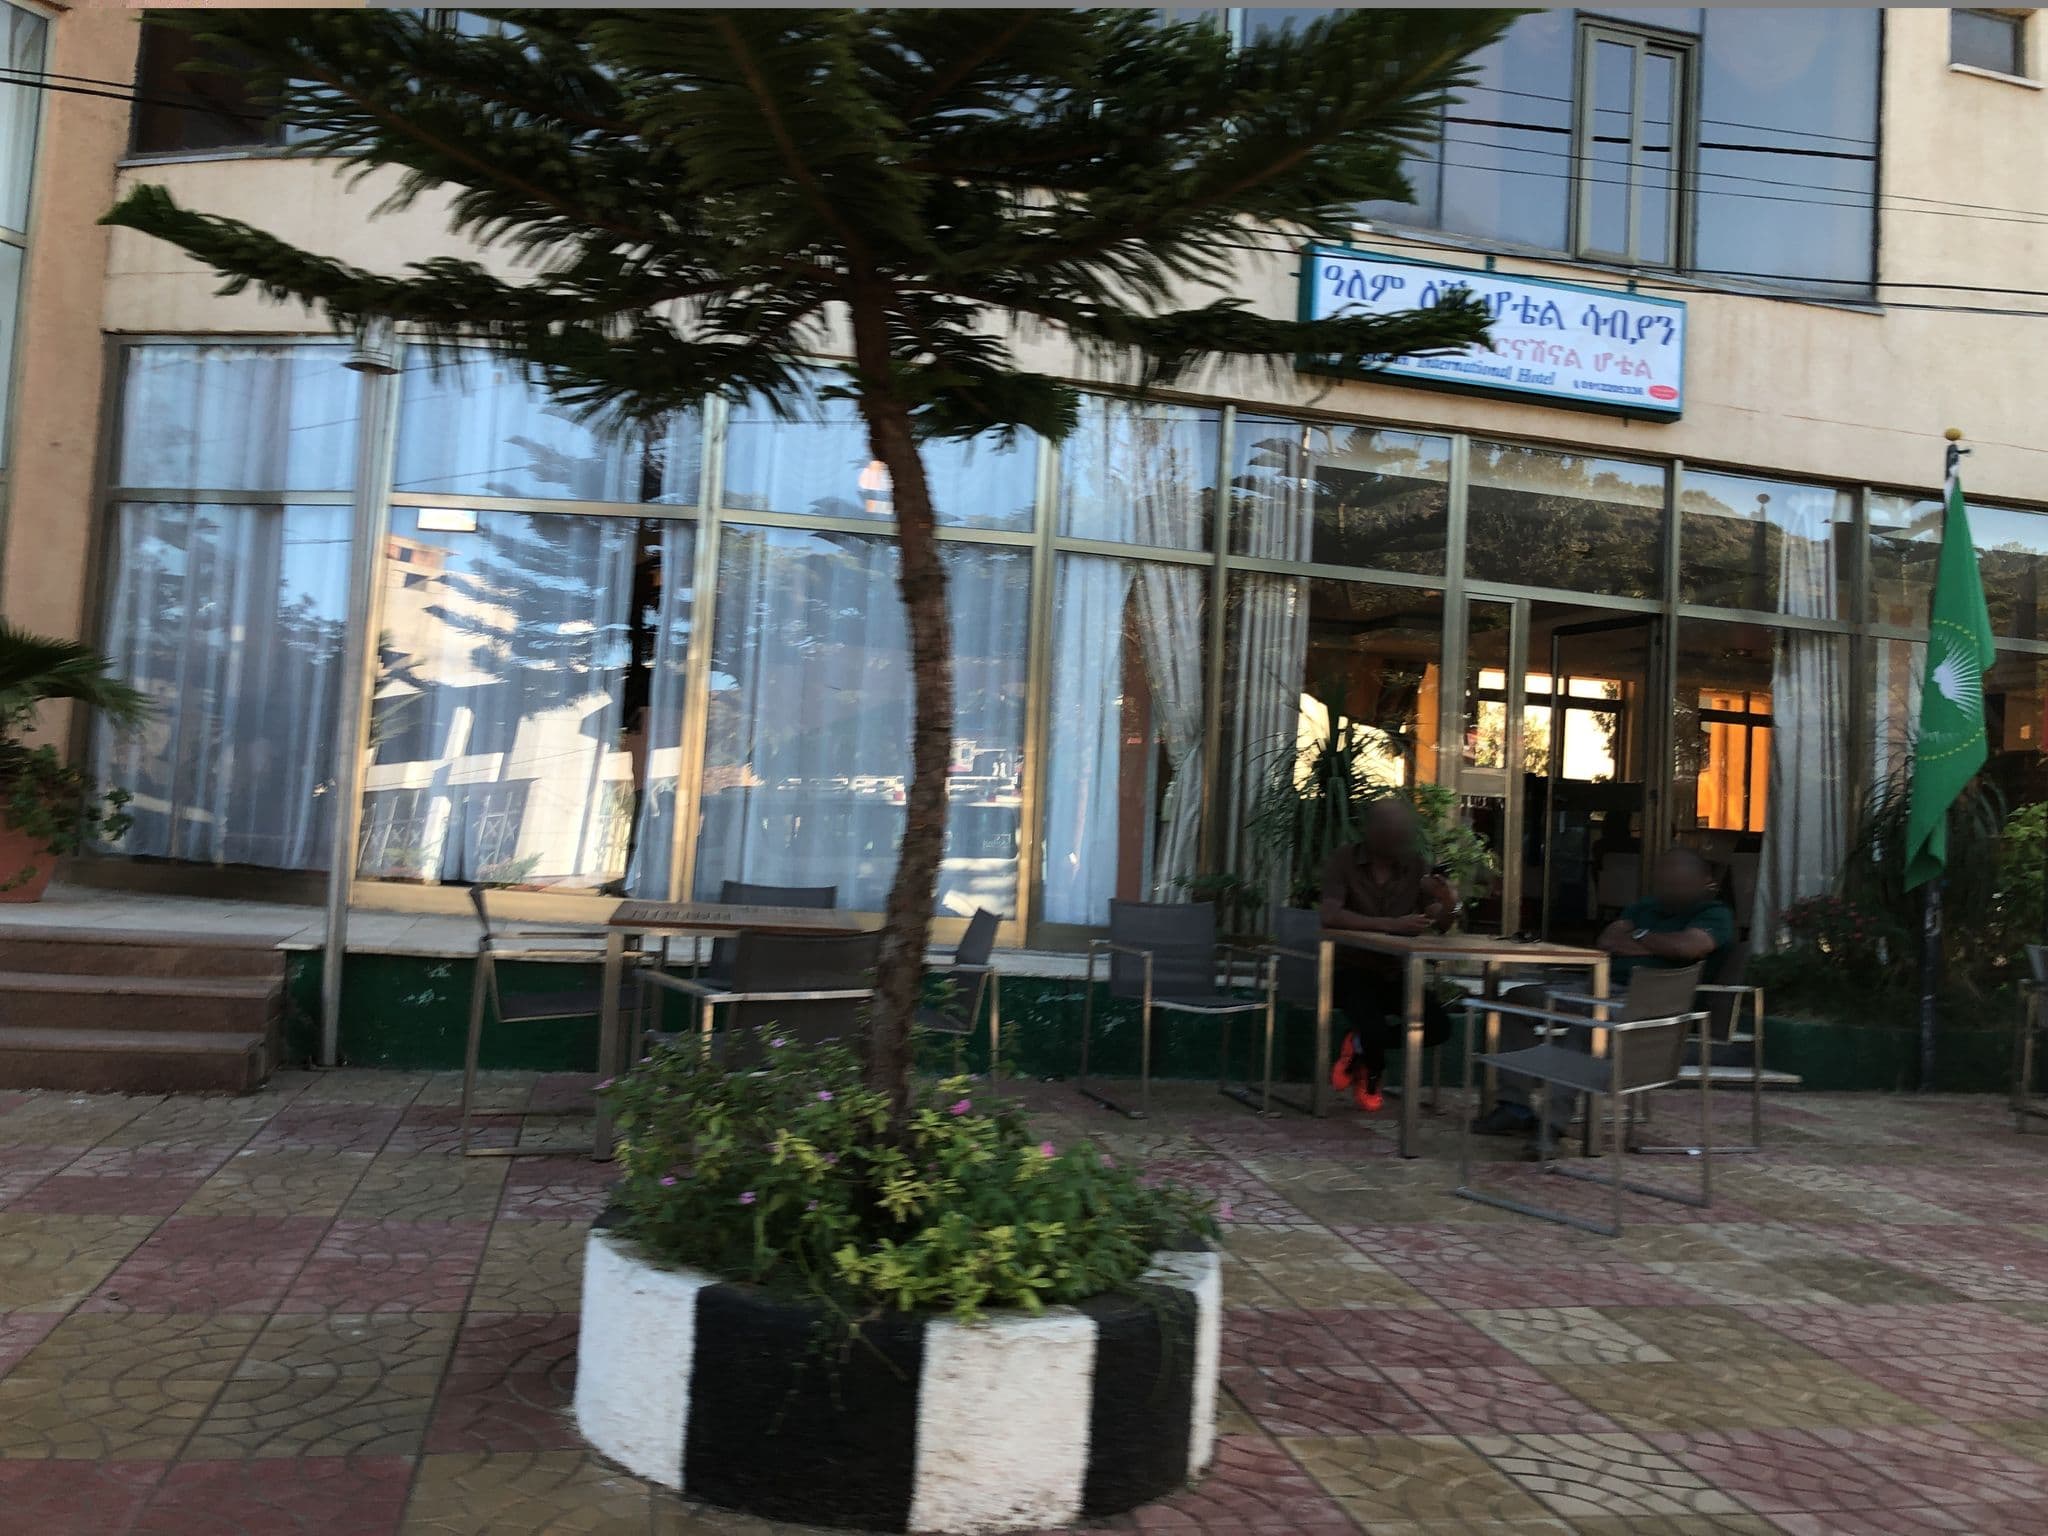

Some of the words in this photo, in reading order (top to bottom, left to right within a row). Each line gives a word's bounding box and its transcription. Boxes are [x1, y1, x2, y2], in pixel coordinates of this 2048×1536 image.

[1325, 265, 1406, 302] ዓለም
[1483, 289, 1567, 330] ሆቴል
[1516, 367, 1557, 387] Hotel
[1594, 351, 1654, 381] ሆቴል
